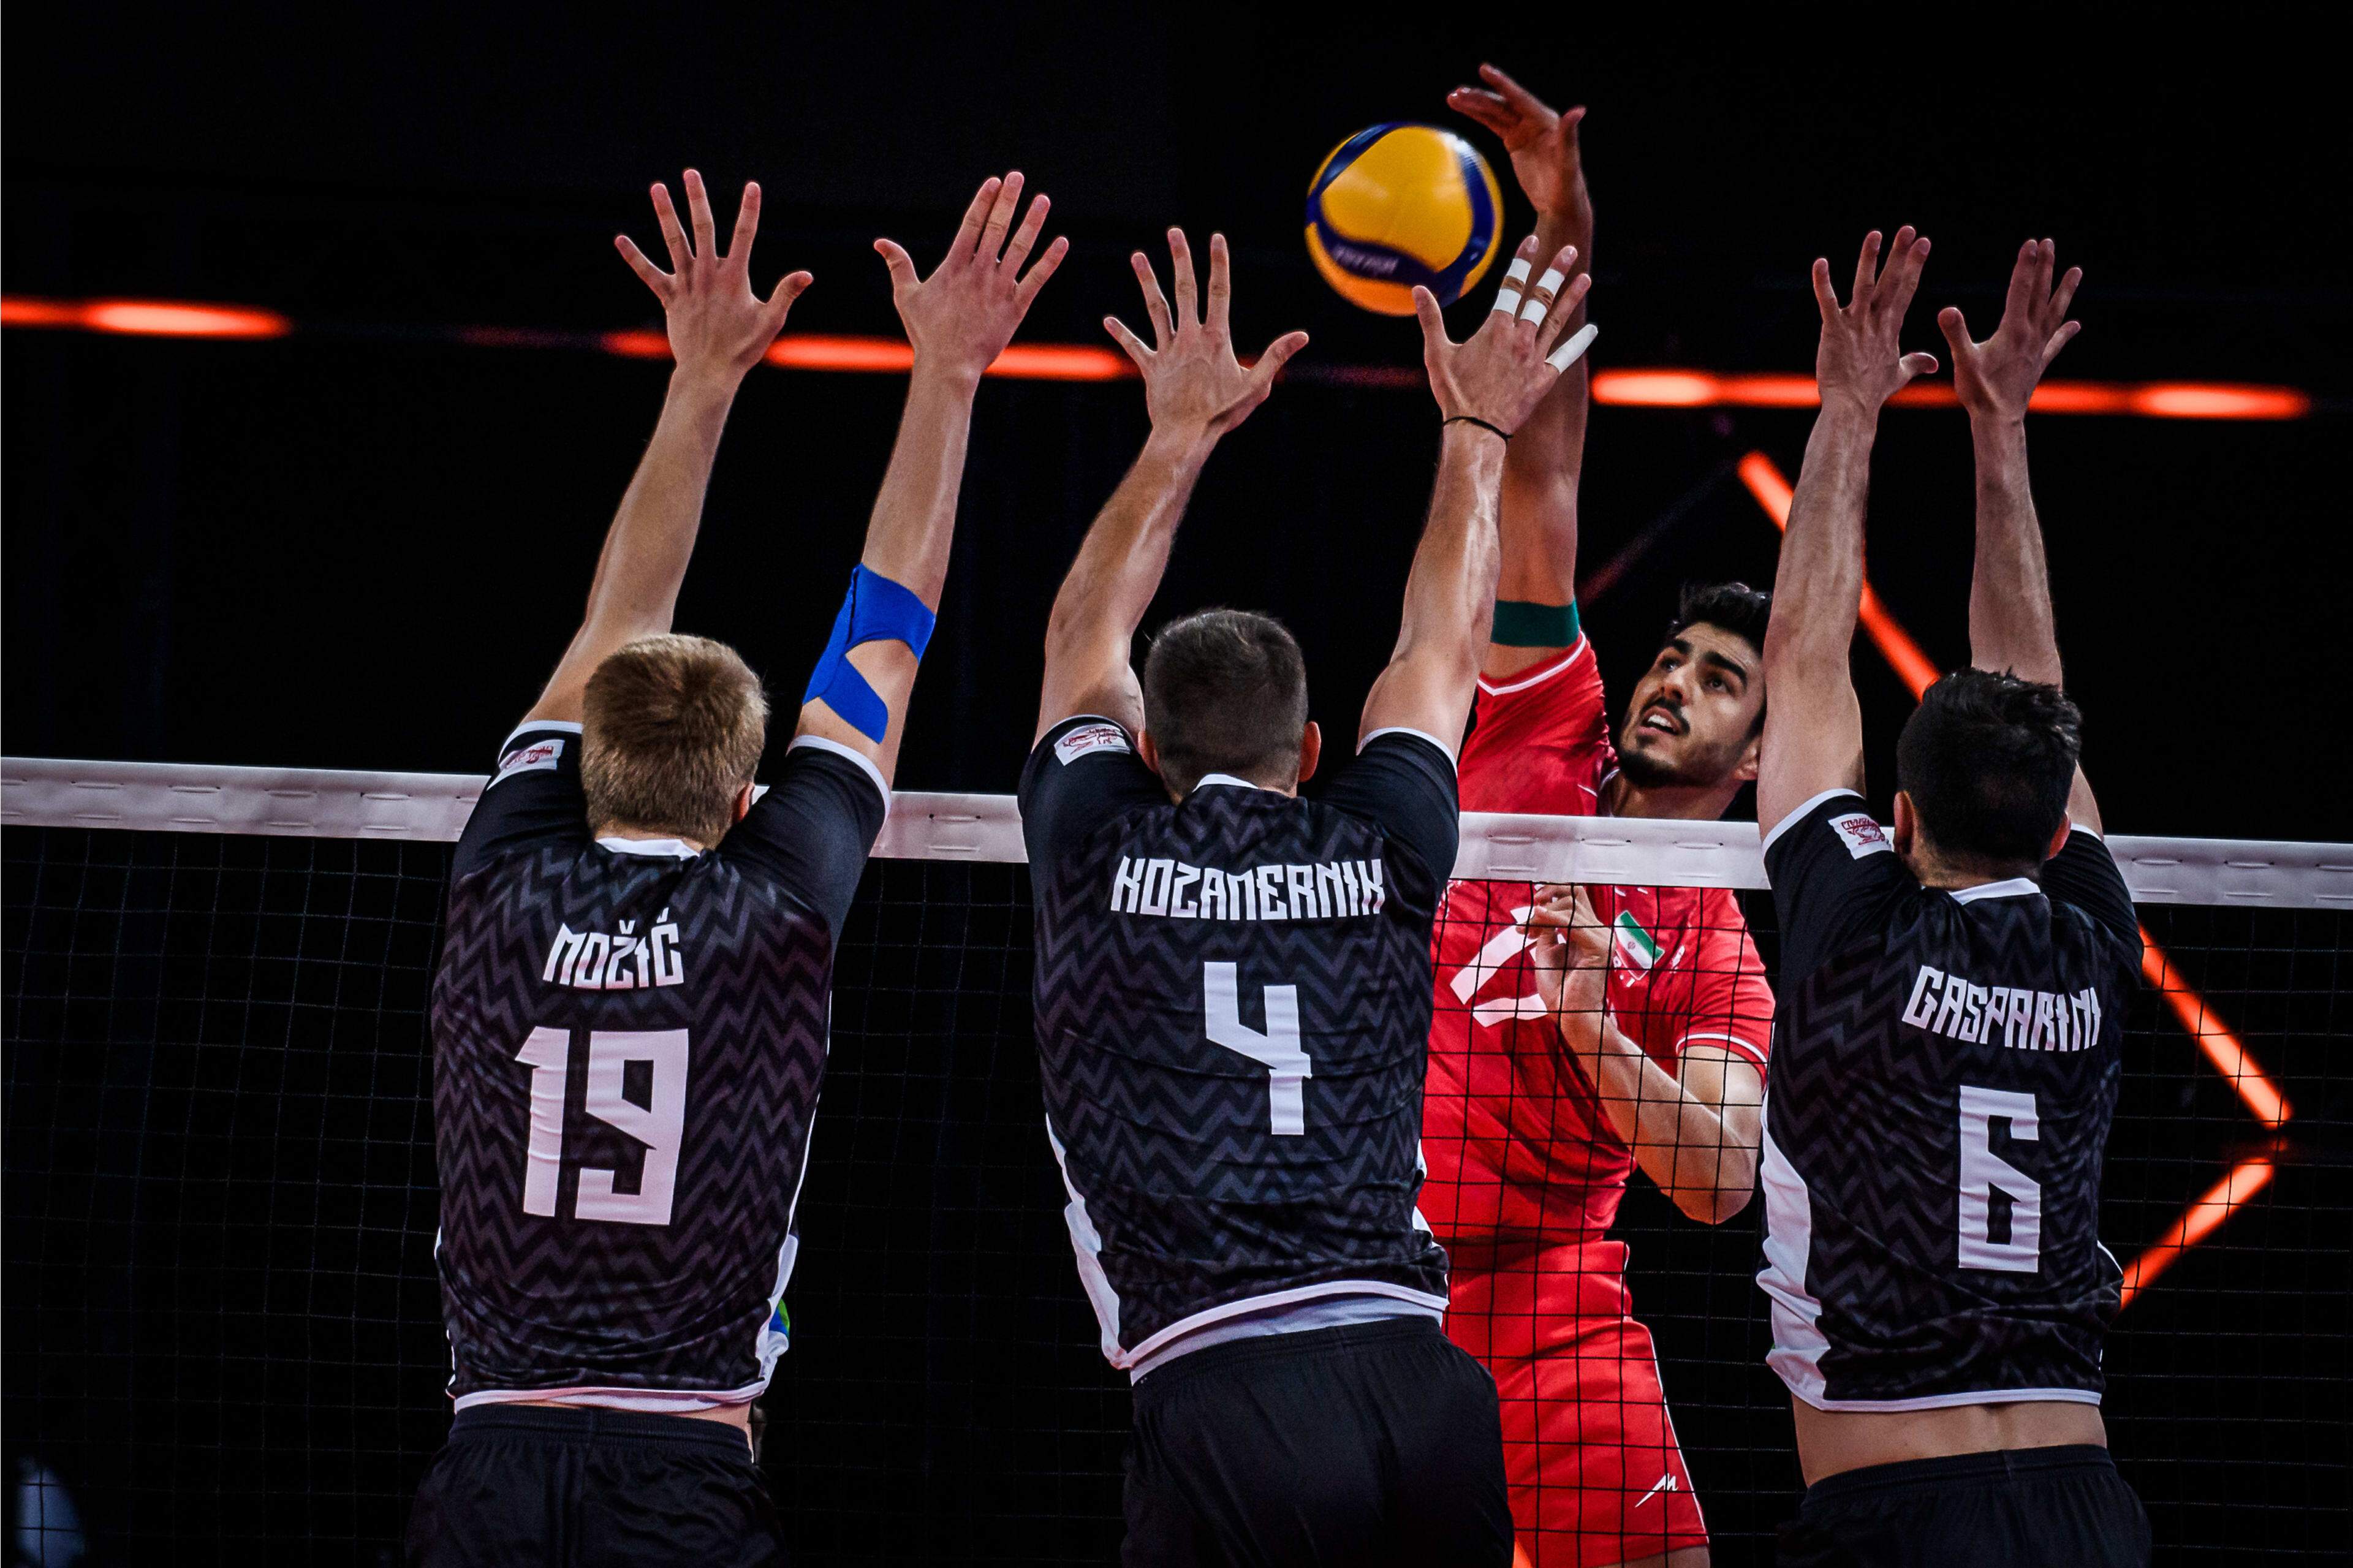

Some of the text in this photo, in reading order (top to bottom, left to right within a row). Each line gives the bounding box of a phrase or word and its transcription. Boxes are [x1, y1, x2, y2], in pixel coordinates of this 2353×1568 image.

[542, 907, 684, 990] MOŽIĆ
[1111, 856, 1385, 920] KOZAMERNIK
[1204, 961, 1313, 1135] 4
[1902, 965, 2101, 1052] GASPARINI
[515, 1026, 689, 1225] 19
[1959, 1085, 2041, 1273] 6
